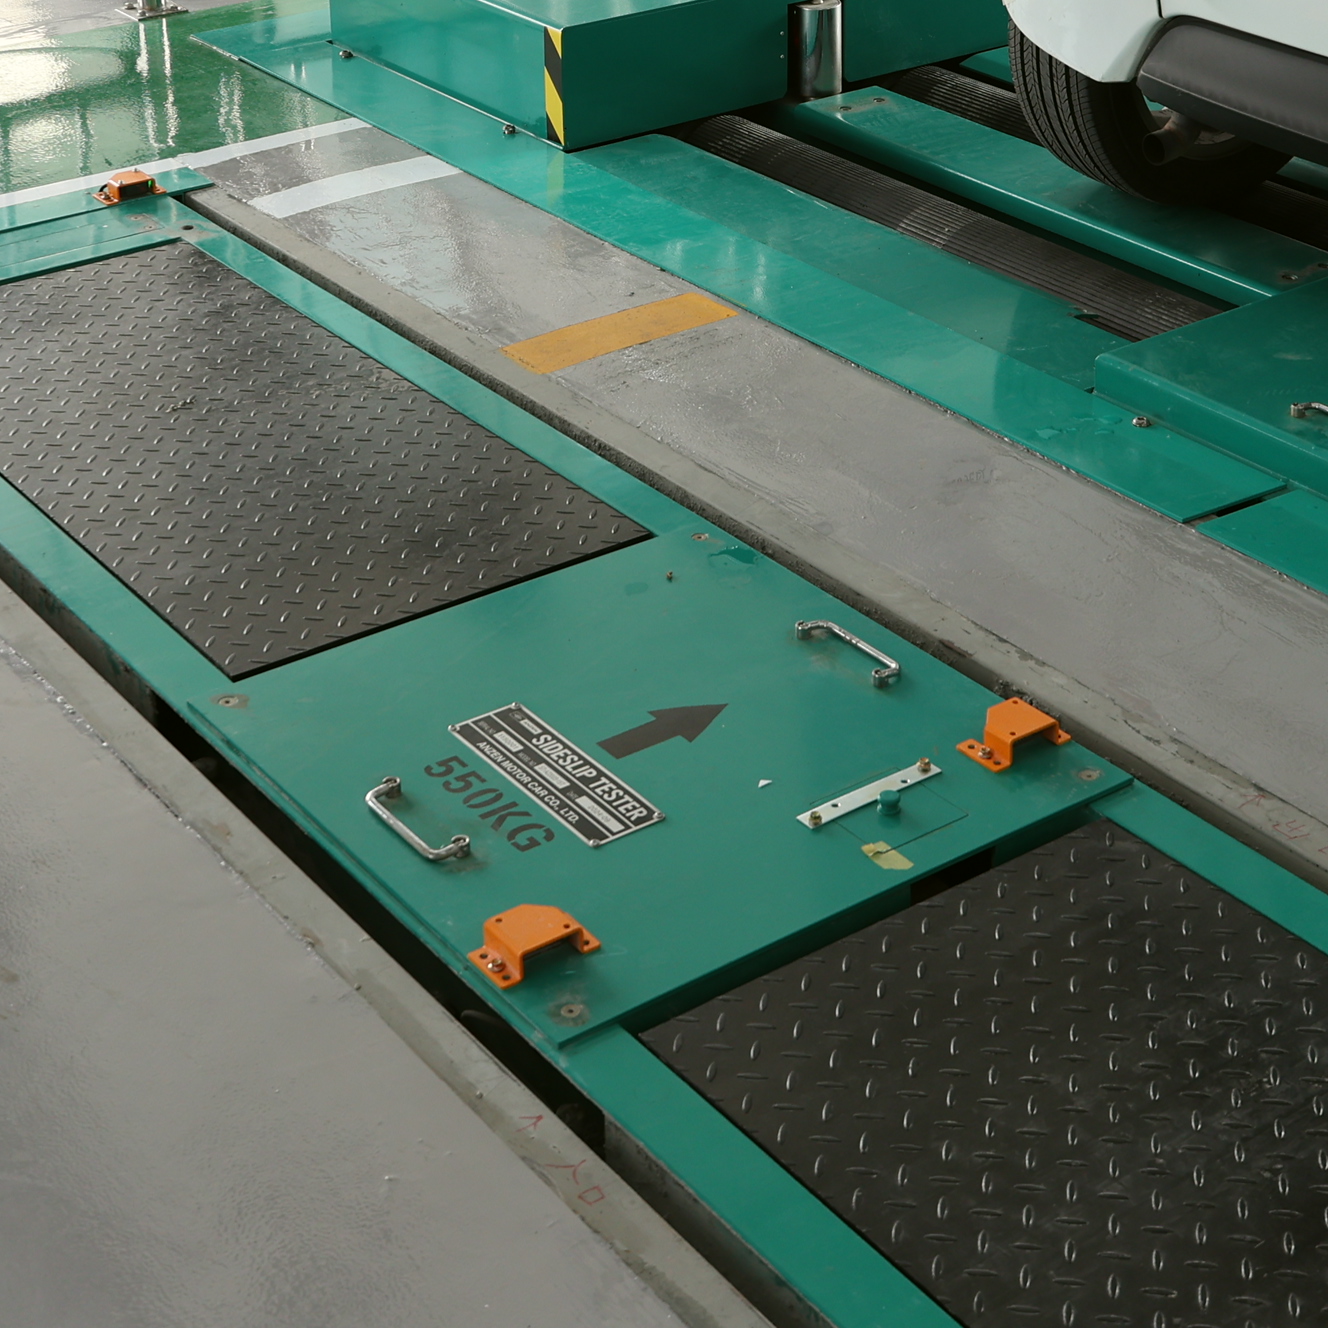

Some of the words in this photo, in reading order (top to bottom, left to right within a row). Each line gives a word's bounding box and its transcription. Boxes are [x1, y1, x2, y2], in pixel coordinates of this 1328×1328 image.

[423, 755, 555, 852] 550KG
[476, 741, 505, 763] ANZEN
[501, 760, 532, 784] MOTOR
[527, 782, 548, 798] CAR
[531, 733, 597, 779] SIDESLIP
[588, 776, 648, 822] TESTER
